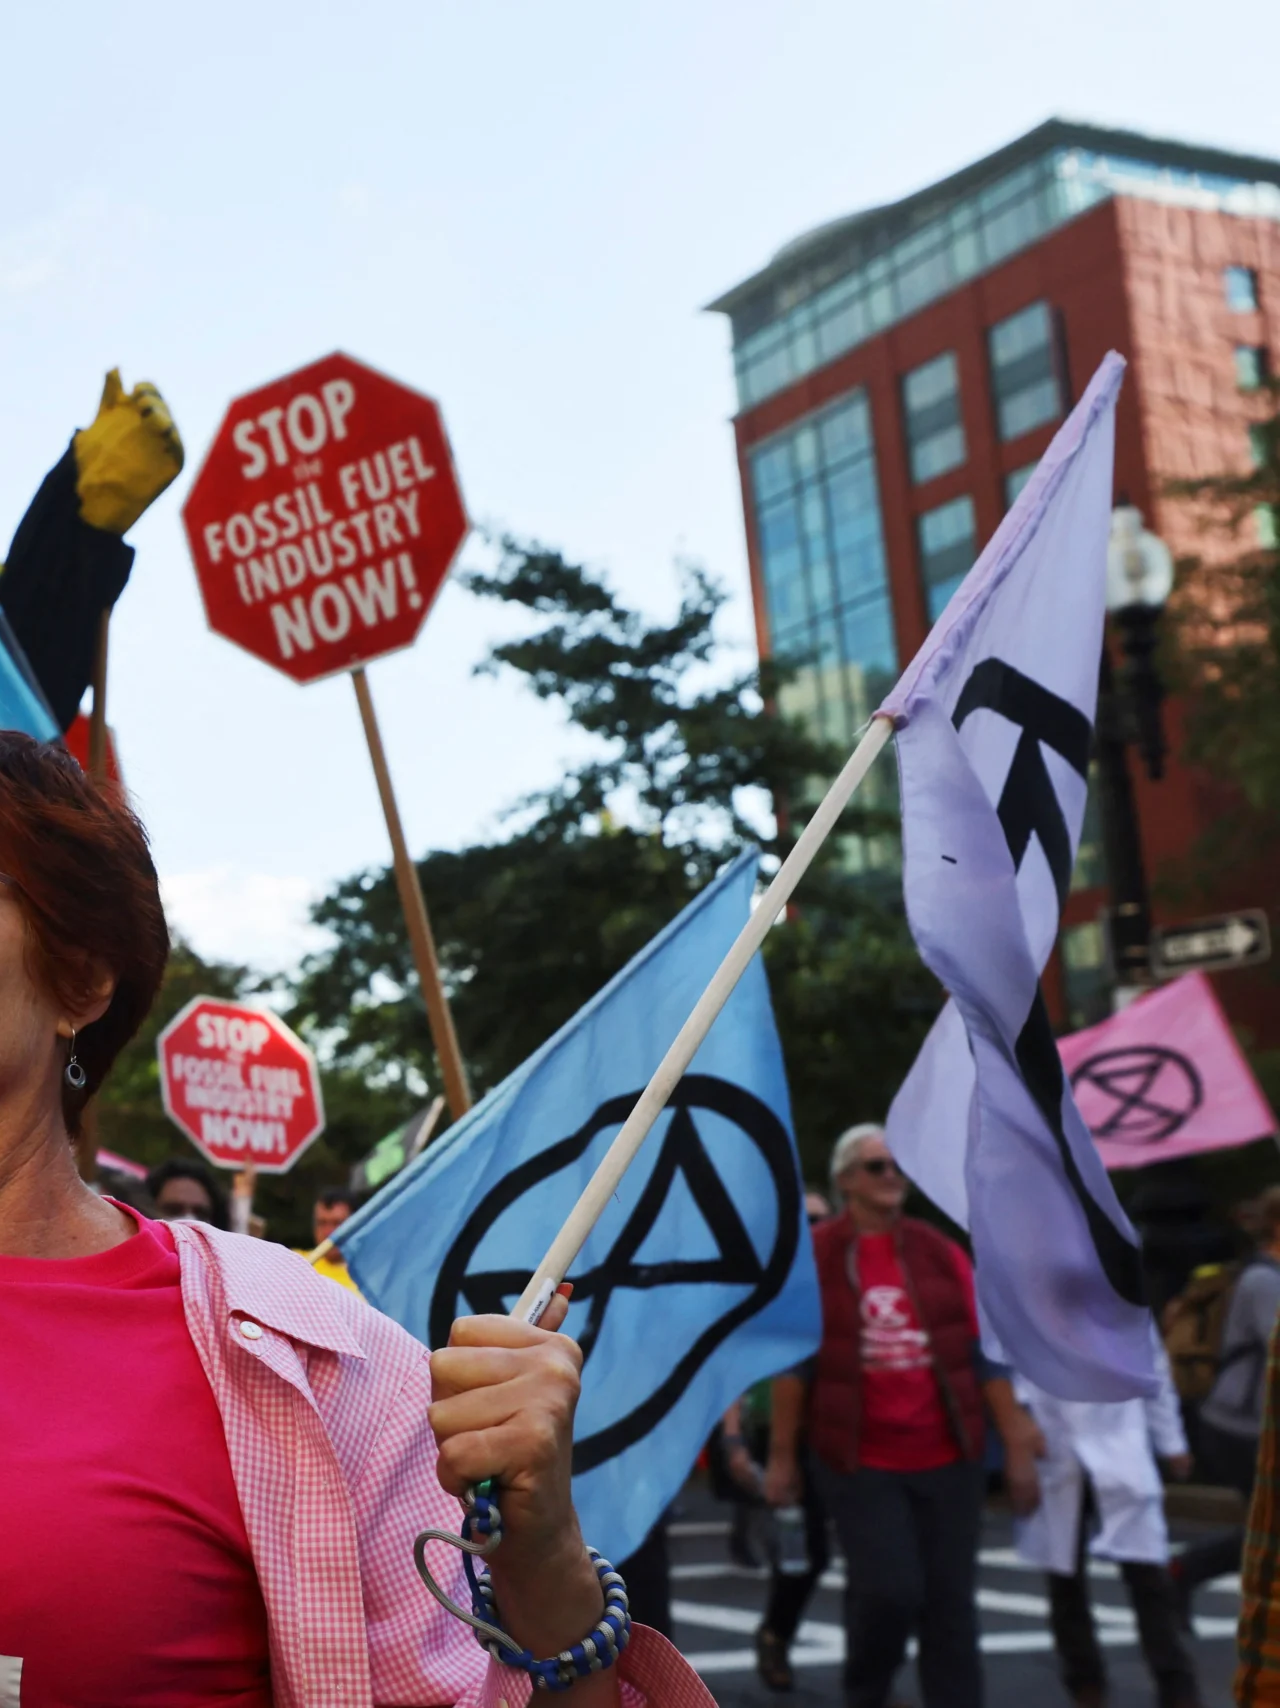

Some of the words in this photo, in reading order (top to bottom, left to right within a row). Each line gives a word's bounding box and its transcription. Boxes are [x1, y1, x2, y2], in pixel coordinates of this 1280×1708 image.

[233, 379, 355, 479] STOP
[204, 483, 333, 562] FOSSIL
[339, 437, 435, 508] FUEL
[235, 491, 420, 605] INDUSTRY
[271, 553, 422, 659] NOW!
[173, 1054, 245, 1089] FOSSIL
[250, 1066, 304, 1097] FUEL
[196, 1013, 269, 1055] STOP
[201, 1113, 287, 1154] NOW!
